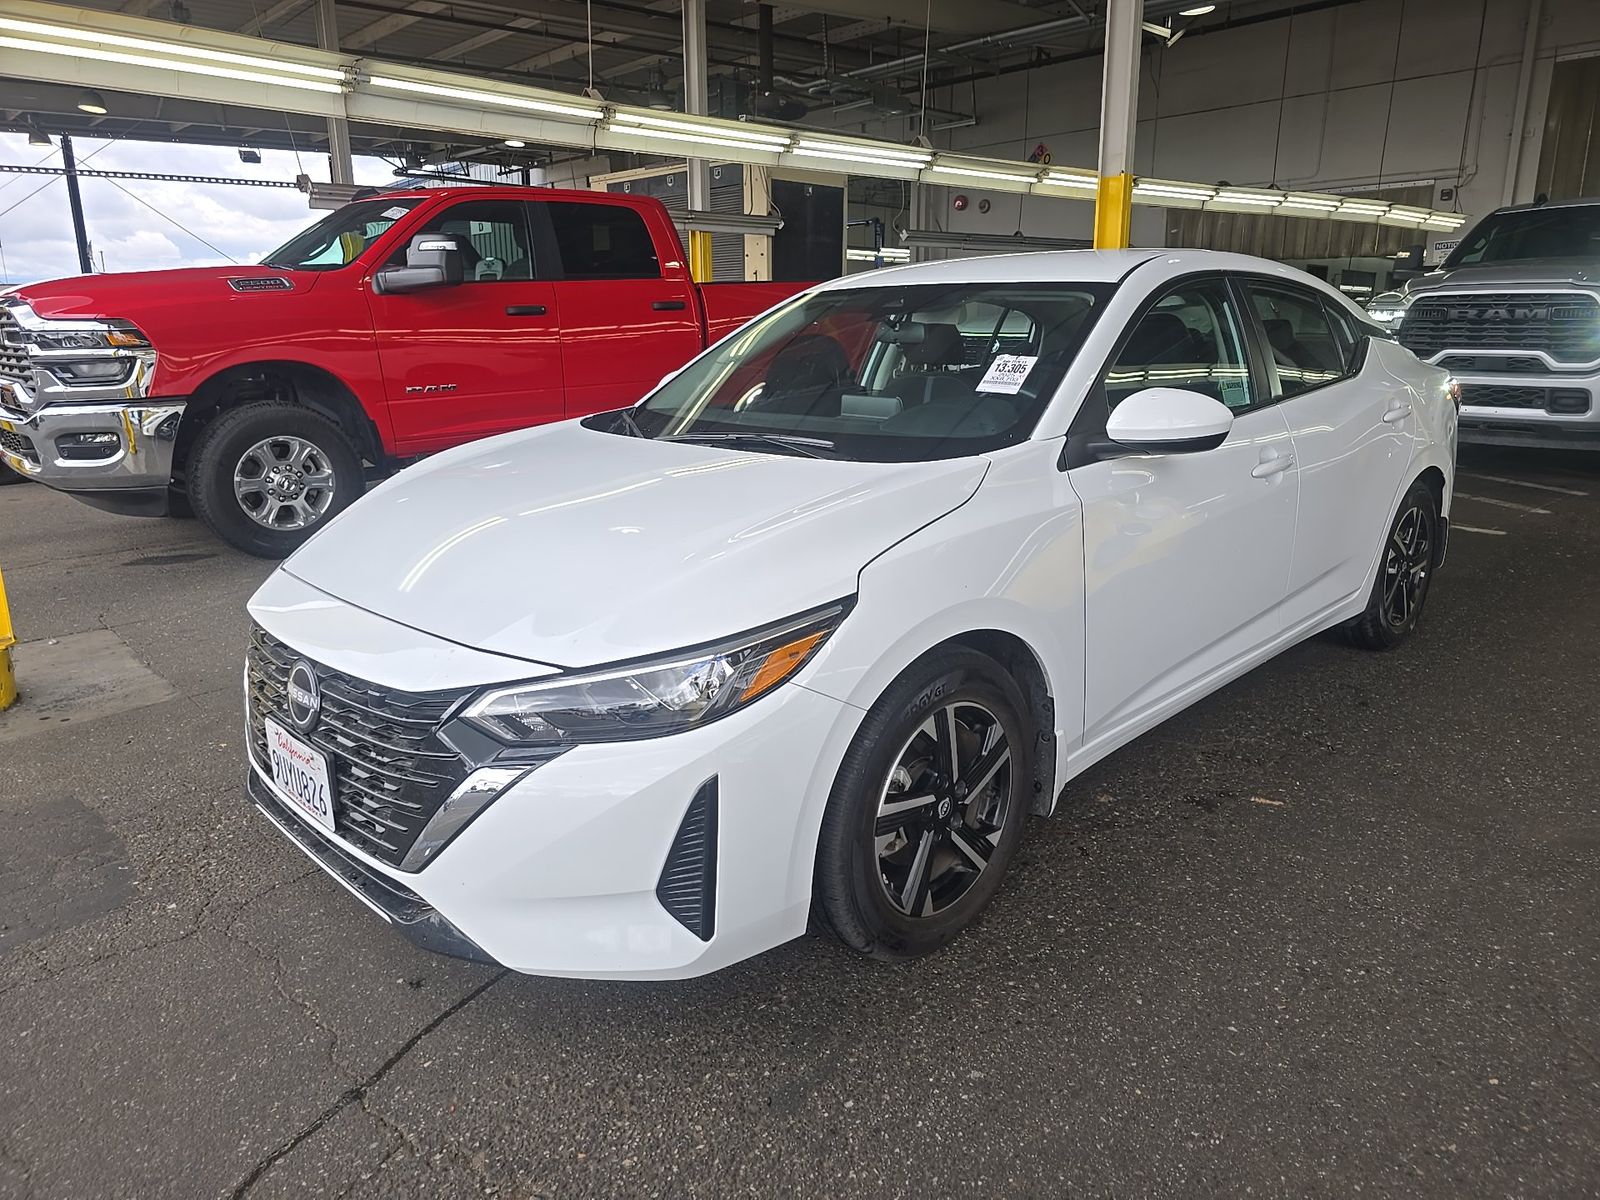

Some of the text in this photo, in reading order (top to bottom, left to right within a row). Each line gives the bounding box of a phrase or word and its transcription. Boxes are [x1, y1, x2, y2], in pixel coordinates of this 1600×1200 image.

[1436, 241, 1459, 250] NOTIC
[1453, 308, 1547, 320] RAM
[994, 362, 1029, 374] 13:305
[288, 681, 319, 709] ISSAN
[272, 749, 328, 817] 9UYU826
